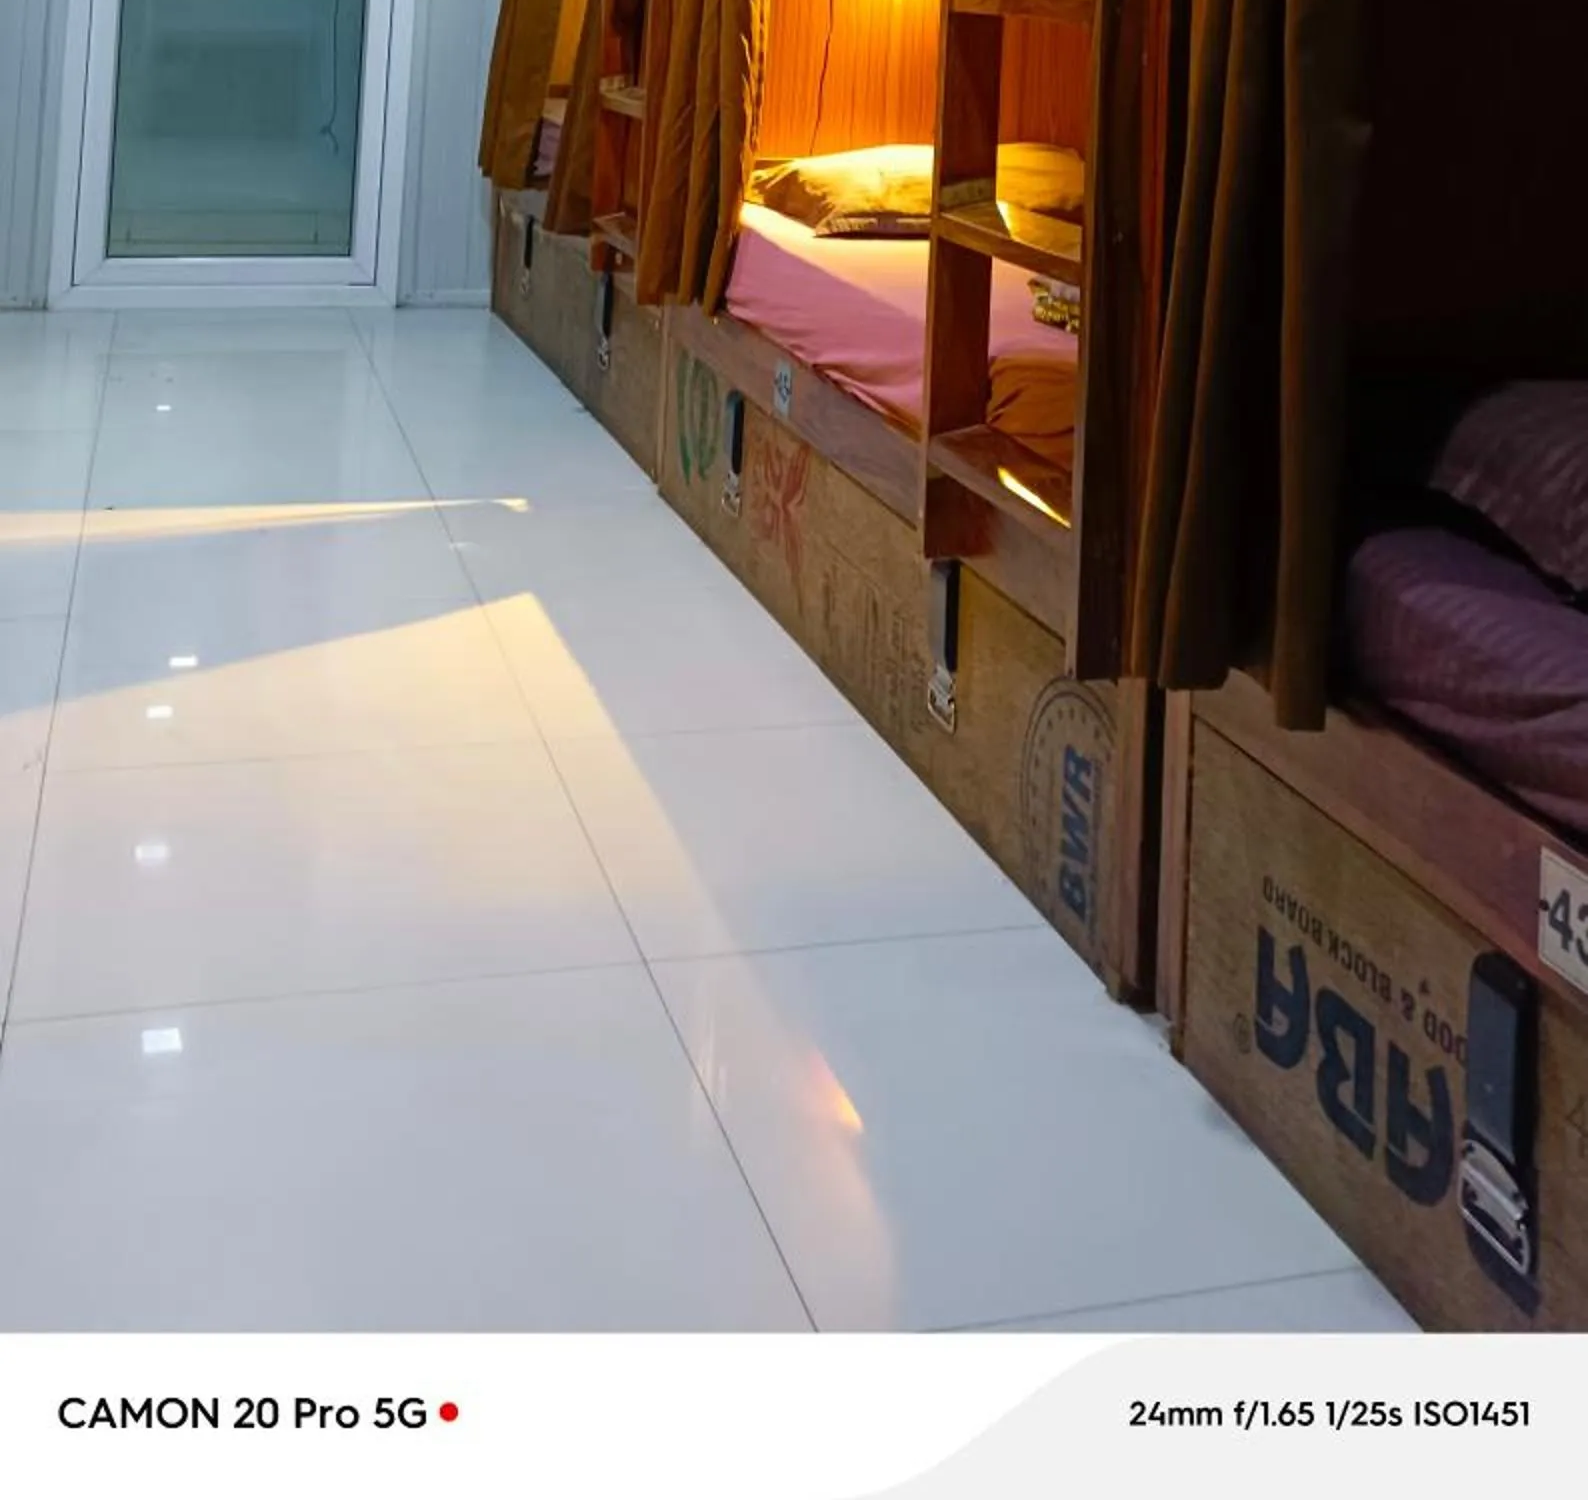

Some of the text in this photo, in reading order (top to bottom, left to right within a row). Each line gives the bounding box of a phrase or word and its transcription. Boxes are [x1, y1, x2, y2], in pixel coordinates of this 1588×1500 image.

[1058, 744, 1093, 921] BWR
[1263, 875, 1322, 945] BOARD
[1328, 930, 1391, 1003] BLOCK
[1255, 926, 1454, 1206] ABA
[1423, 1011, 1467, 1066] OOD
